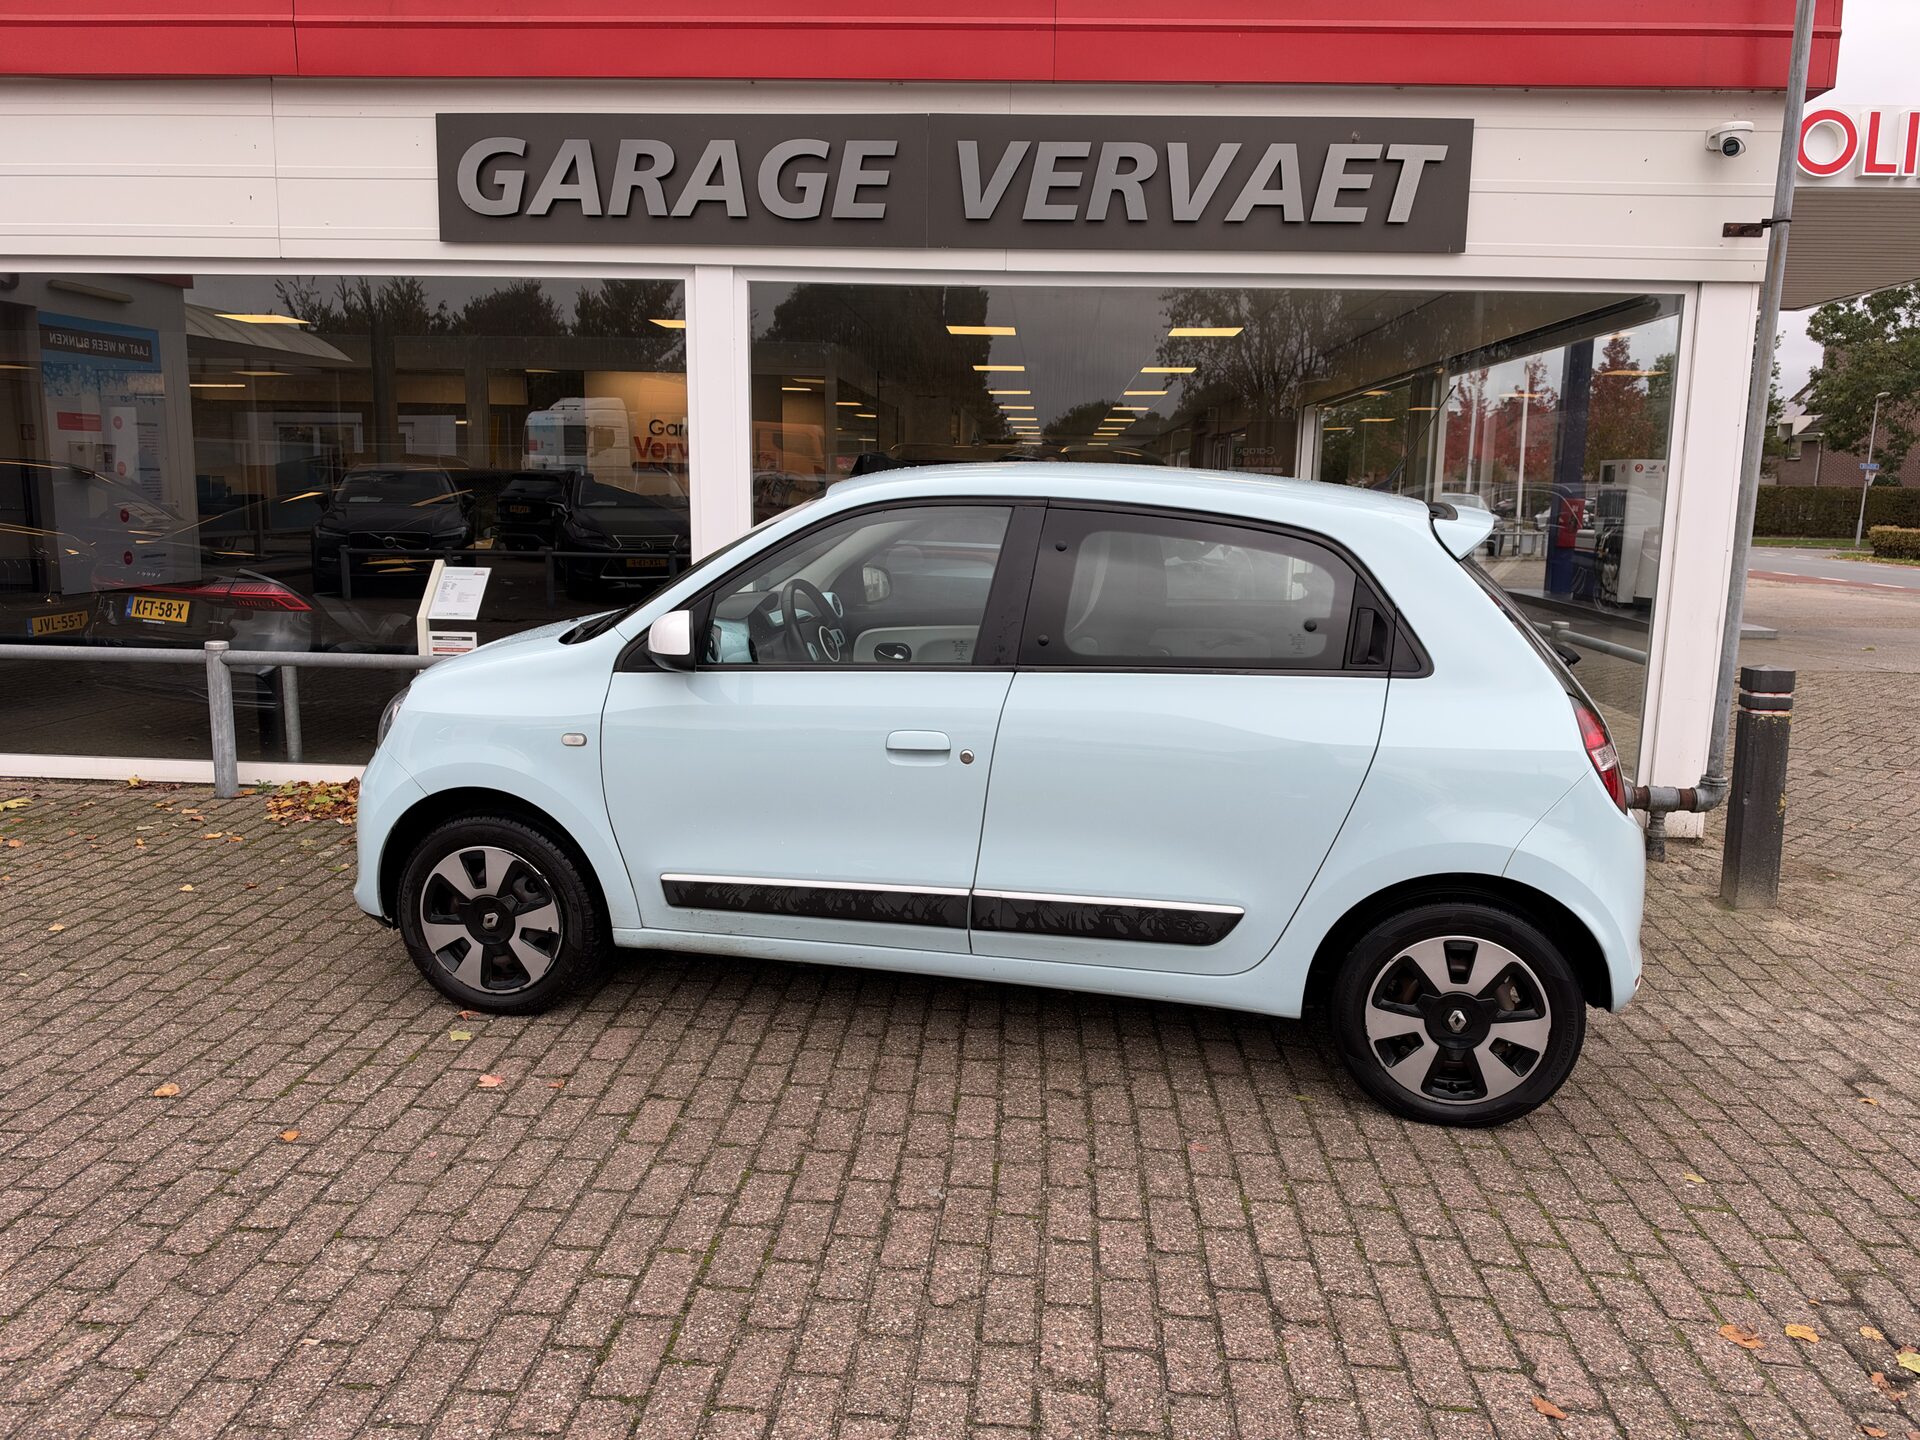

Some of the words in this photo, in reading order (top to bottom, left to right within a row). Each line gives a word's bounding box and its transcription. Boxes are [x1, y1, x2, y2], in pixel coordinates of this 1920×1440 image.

[456, 136, 899, 221] GARAGE
[956, 139, 1449, 224] VERVAET
[649, 419, 688, 437] Gar
[134, 600, 185, 619] KFT-58-X
[37, 613, 84, 632] JVL-55-T
[1102, 912, 1210, 935] TWINGO
